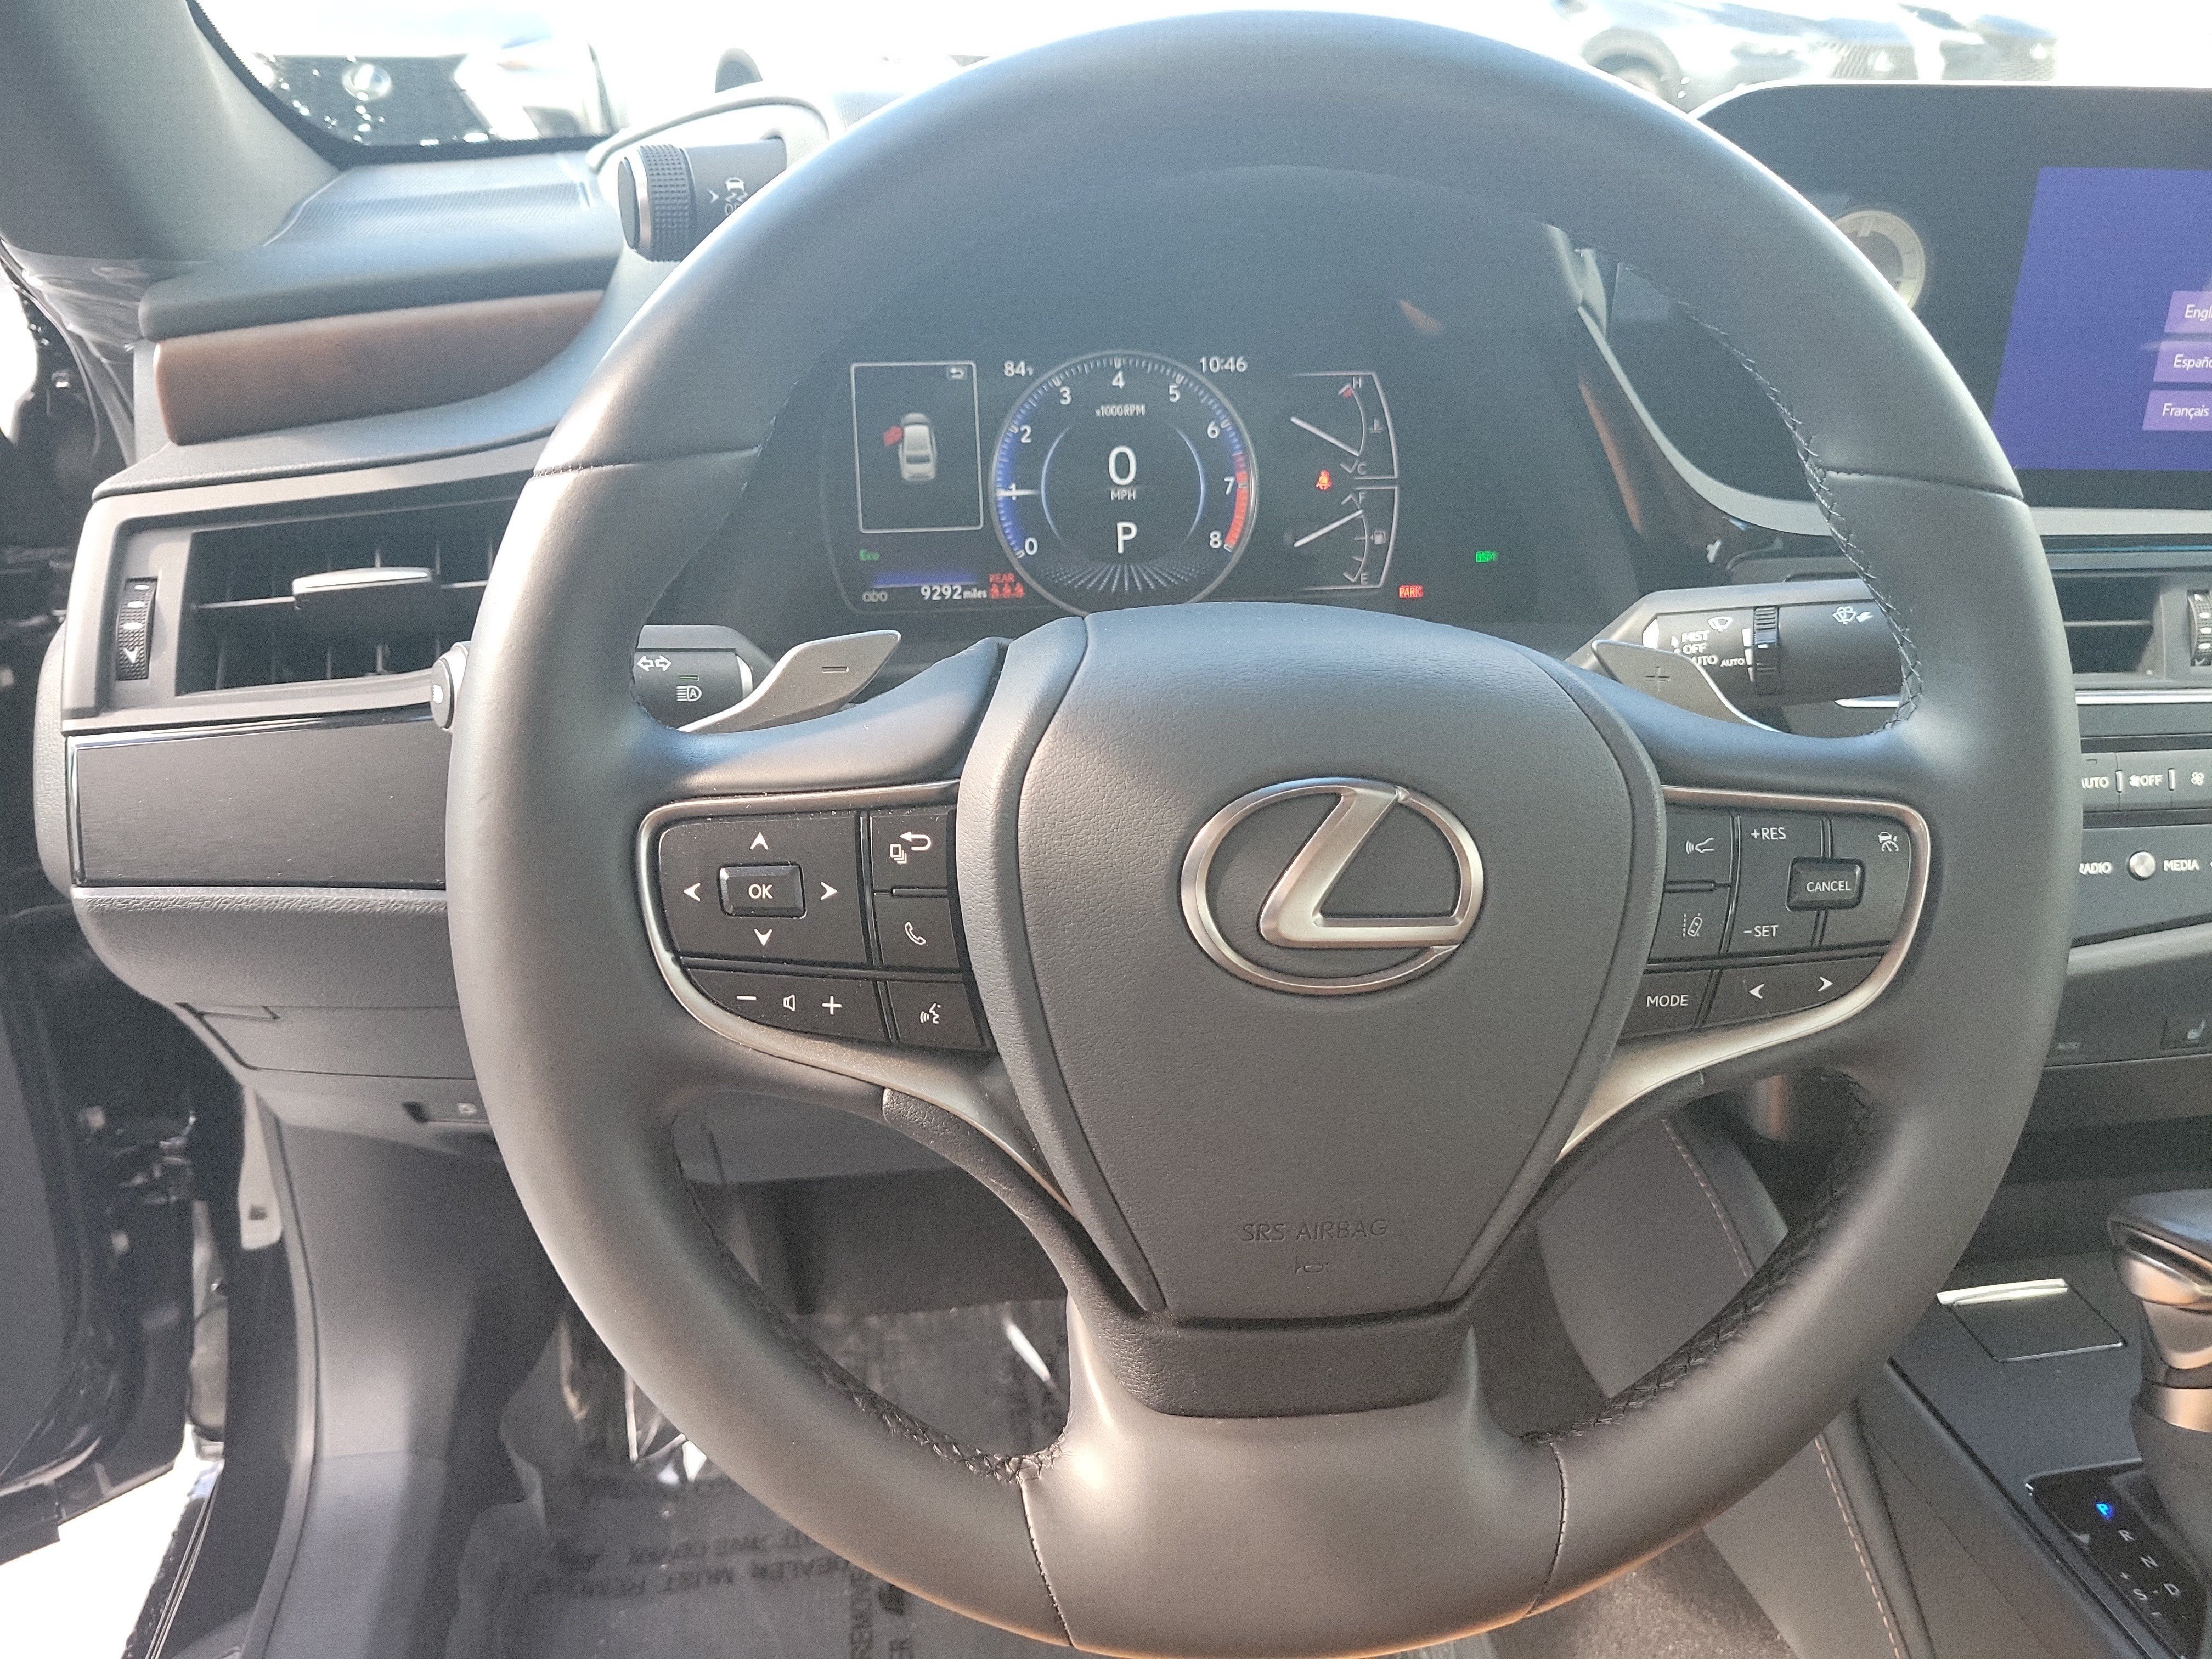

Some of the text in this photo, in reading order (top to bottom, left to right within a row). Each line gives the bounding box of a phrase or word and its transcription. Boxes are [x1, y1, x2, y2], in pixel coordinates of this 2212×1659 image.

[1200, 357, 1248, 373] 10:46
[1111, 371, 1125, 388] 4
[1059, 386, 1071, 405] 3
[1168, 385, 1181, 402] 5
[2162, 403, 2209, 420] Français
[1020, 426, 1031, 443] 2
[1207, 423, 1220, 439] 6
[1224, 477, 1234, 495] 7
[1110, 488, 1137, 501] MPH
[1115, 521, 1138, 554] P
[1209, 531, 1222, 549] 8
[1024, 537, 1038, 556] 0
[862, 584, 988, 603] ODO 9292 miles
[1399, 585, 1423, 599] PARK
[1681, 630, 1710, 643] MIST
[1683, 642, 1707, 654] OFF
[1720, 657, 1745, 667] AUTO
[2140, 774, 2164, 787] OFF
[2163, 859, 2200, 872] MEDIA
[748, 884, 773, 899] OK
[1807, 880, 1851, 893] CANCEL
[1646, 995, 1689, 1008] MODE
[1242, 1218, 1387, 1242] SRS AIRBAG
[2118, 1529, 2135, 1541] R
[2140, 1555, 2159, 1569] N
[2132, 1583, 2181, 1601] S D
